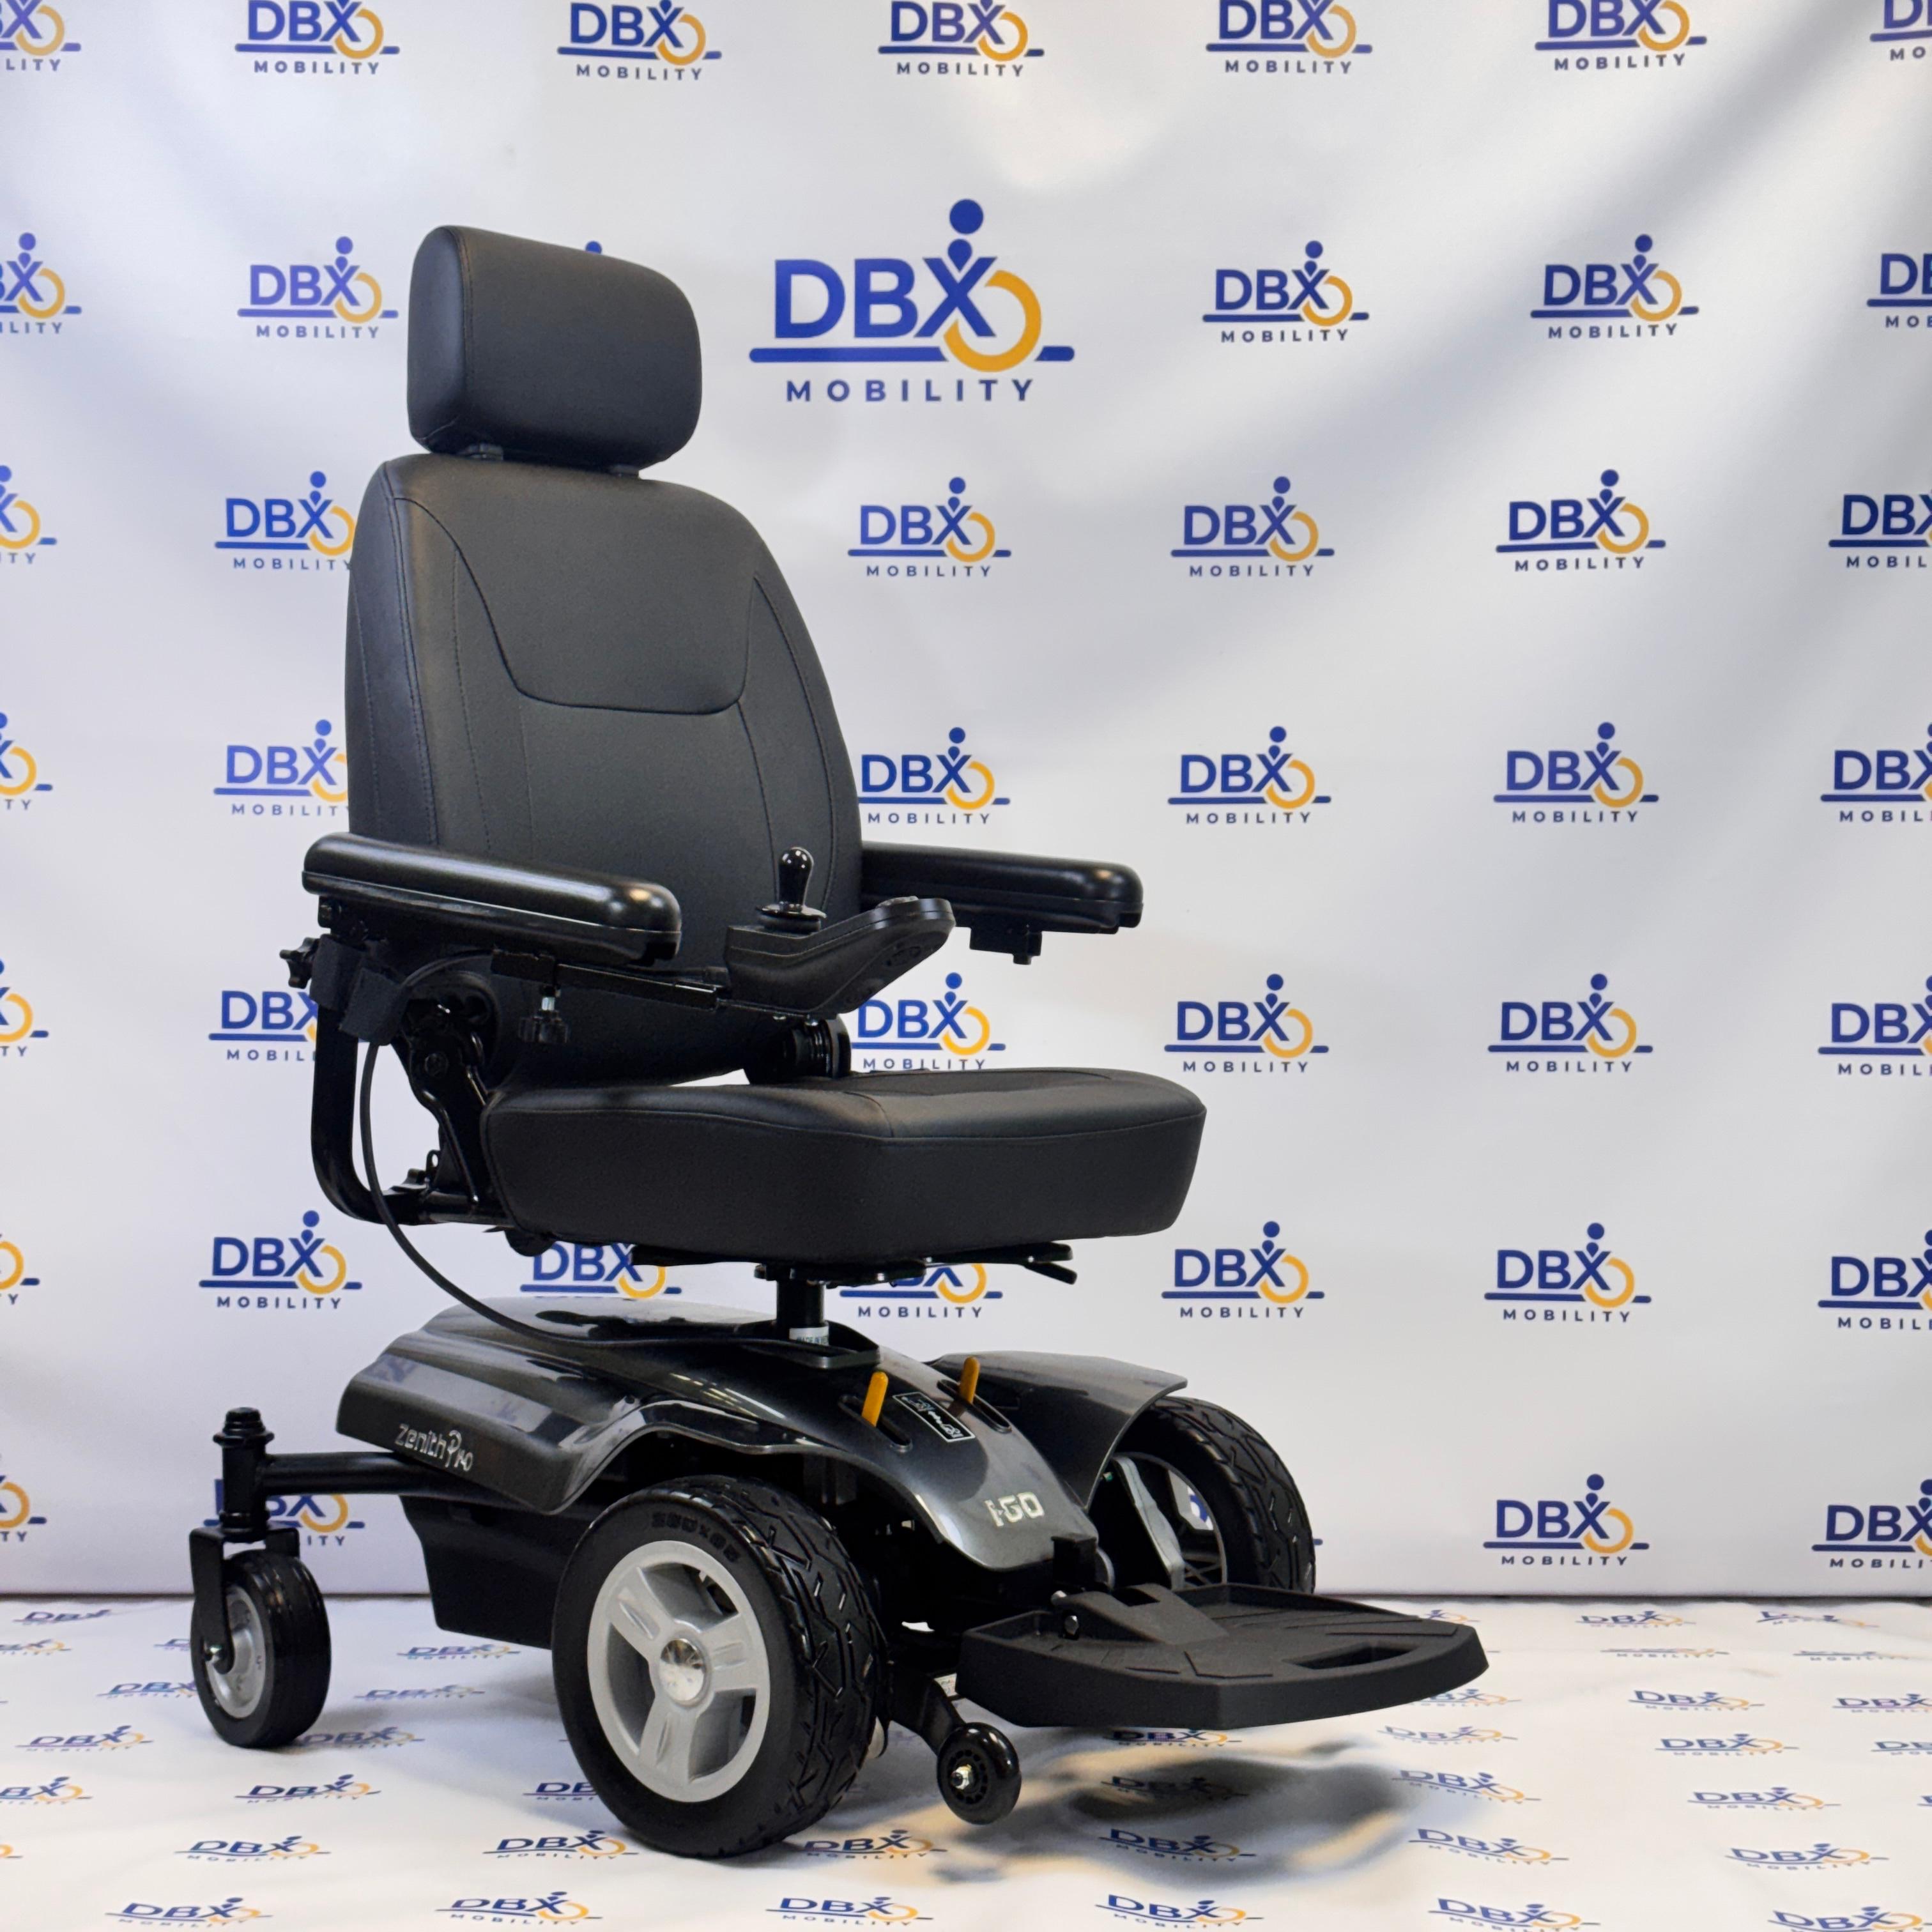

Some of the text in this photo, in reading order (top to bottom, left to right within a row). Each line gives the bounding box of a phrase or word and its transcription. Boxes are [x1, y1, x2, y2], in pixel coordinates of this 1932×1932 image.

[254, 61, 379, 74] MOBILITY
[897, 61, 1023, 77] MOBILITY
[1225, 59, 1351, 73] MOBILITY
[1554, 54, 1685, 71] MOBILITY
[576, 65, 701, 80] MOBILITY
[257, 325, 378, 338] MOBILITY
[1221, 329, 1347, 343] MOBILITY
[1548, 323, 1677, 339] MOBILITY
[786, 379, 1032, 402] MOBILITY
[1515, 556, 1644, 572] MOBILITY
[866, 565, 990, 577] MOBILITY
[1190, 565, 1313, 577] MOBILITY
[866, 813, 990, 824] MOBILITY
[1186, 812, 1310, 824] MOBILITY
[1512, 811, 1637, 823] MOBILITY
[863, 1059, 985, 1070] MOBILITY
[1183, 1061, 1308, 1073] MOBILITY
[1506, 1061, 1631, 1073] MOBILITY
[217, 1296, 341, 1309] MOBILITY
[858, 1307, 983, 1318] MOBILITY
[1180, 1307, 1303, 1318] MOBILITY
[1503, 1309, 1630, 1322] MOBILITY
[1501, 1556, 1627, 1566] MOBILITY
